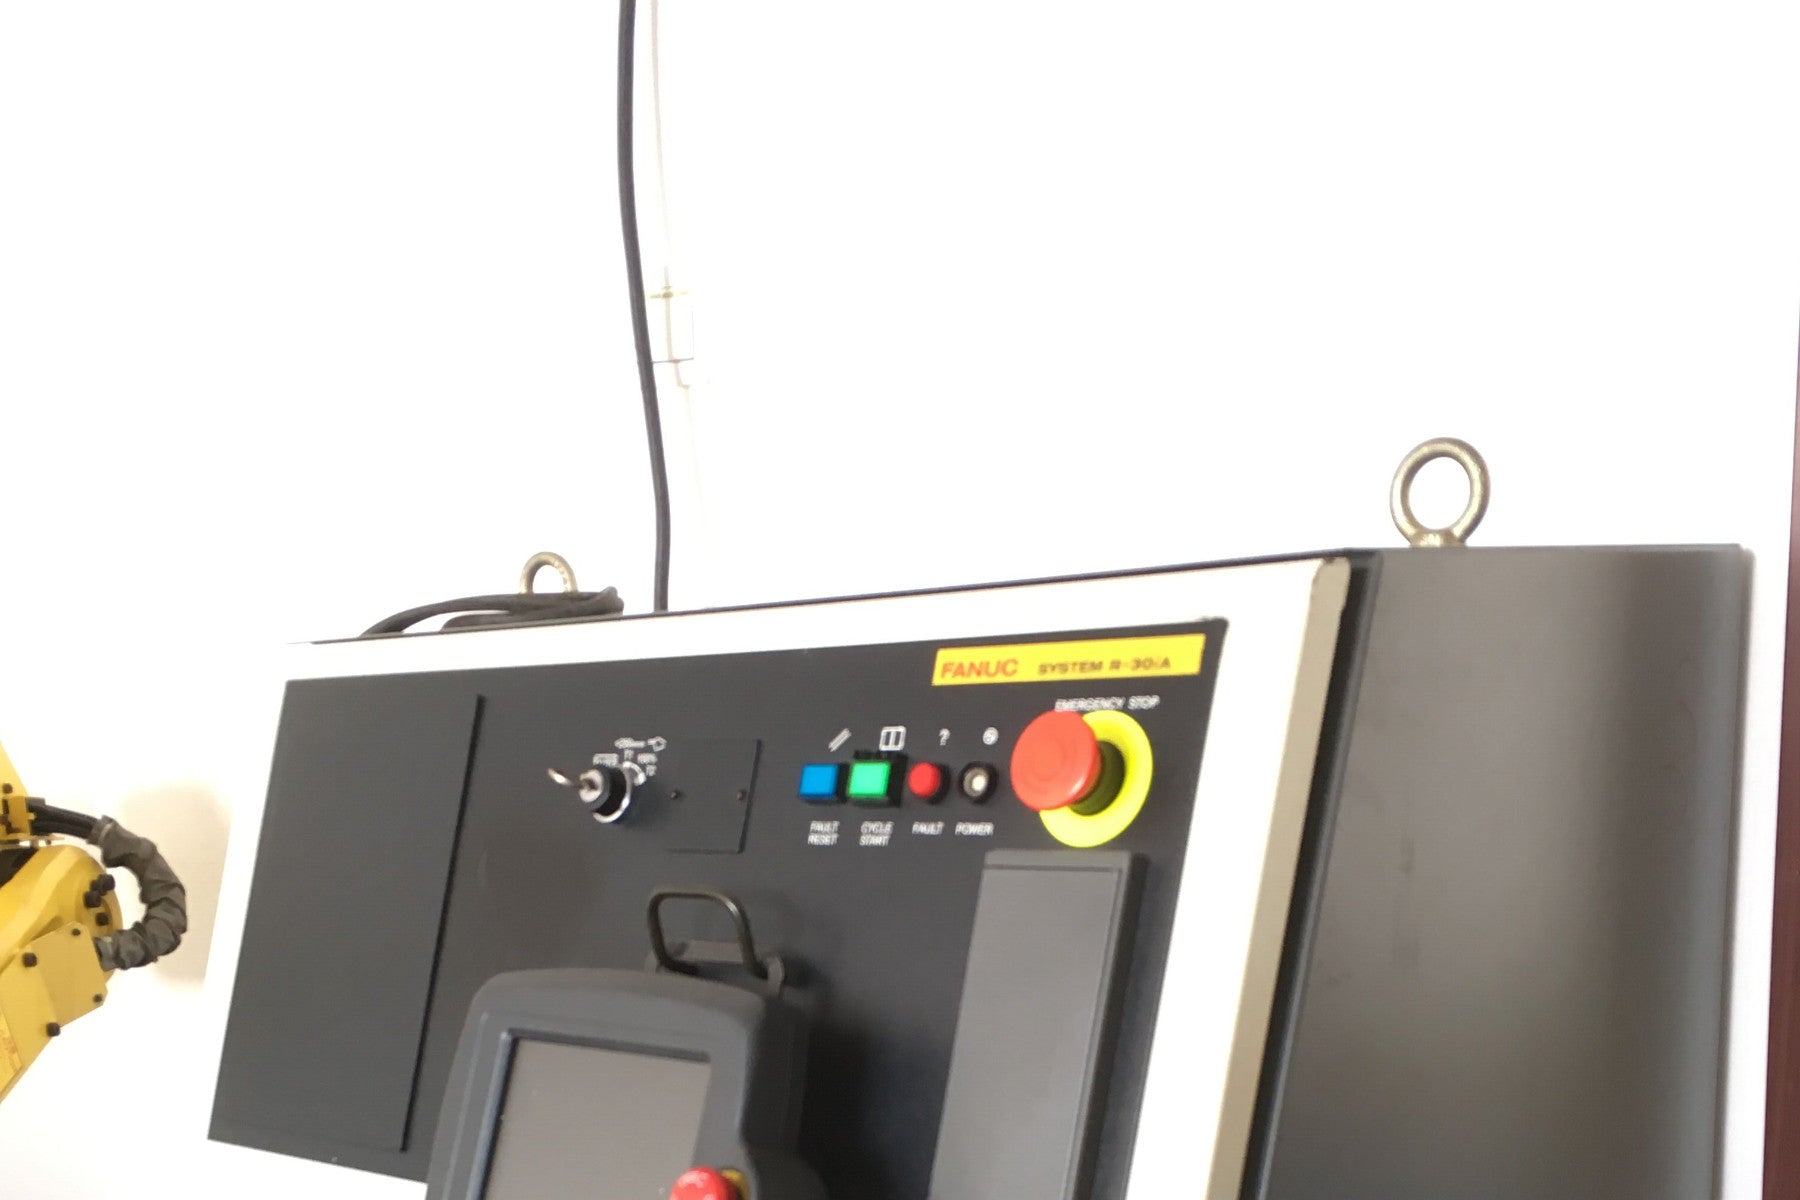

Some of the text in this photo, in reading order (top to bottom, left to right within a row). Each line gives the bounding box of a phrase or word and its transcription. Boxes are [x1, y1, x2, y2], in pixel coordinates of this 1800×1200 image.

[940, 658, 1019, 679] FANUC
[1037, 660, 1103, 676] SYSTEM
[1054, 695, 1160, 712] EMERGENCY STOP
[810, 820, 840, 833] FAULT
[861, 820, 894, 834] CYCLE
[911, 821, 945, 836] FAULT
[955, 821, 994, 837] POWER
[807, 833, 839, 846] RESET
[859, 834, 889, 846] START
